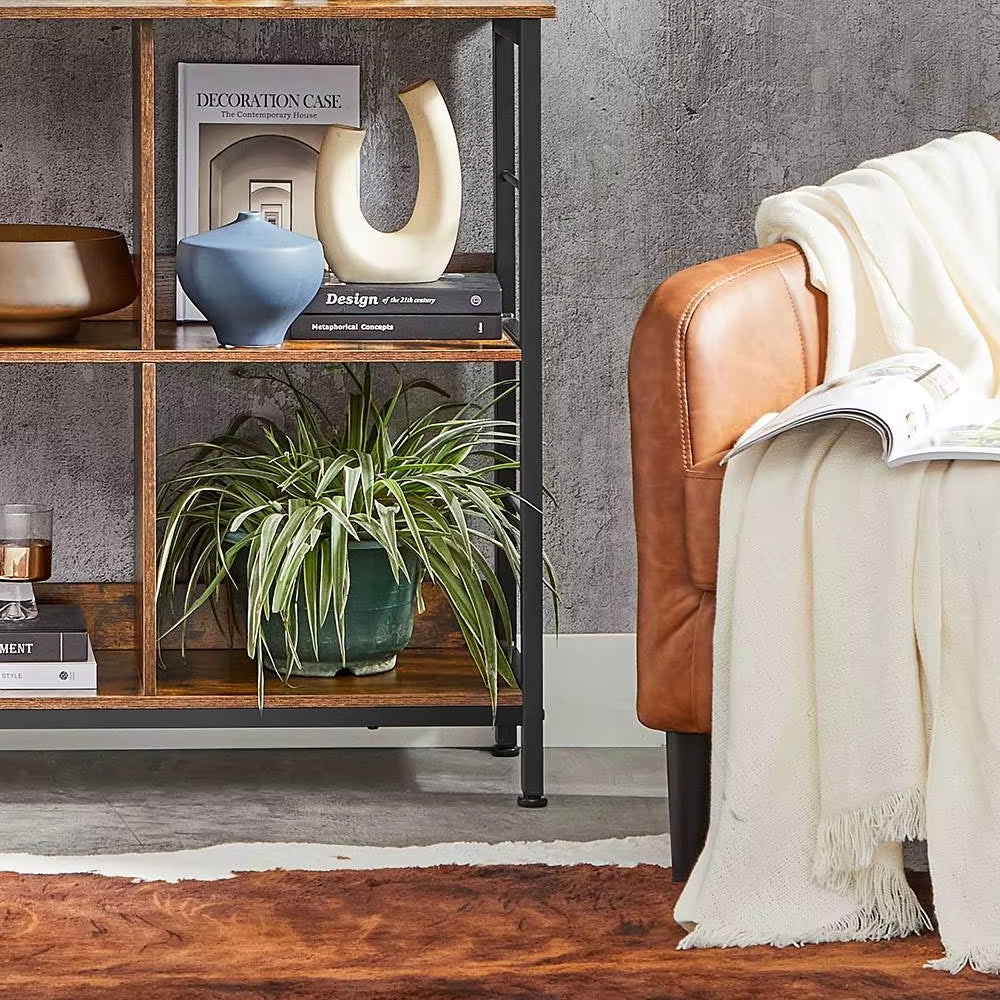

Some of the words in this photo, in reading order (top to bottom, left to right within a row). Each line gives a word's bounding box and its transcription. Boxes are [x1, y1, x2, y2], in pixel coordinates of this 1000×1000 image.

[197, 92, 300, 108] DECORATION
[303, 94, 342, 109] CASE
[236, 111, 292, 120] Contemporary
[325, 293, 379, 308] Design
[311, 324, 358, 332] Metaphorical
[361, 324, 394, 332] Concepts
